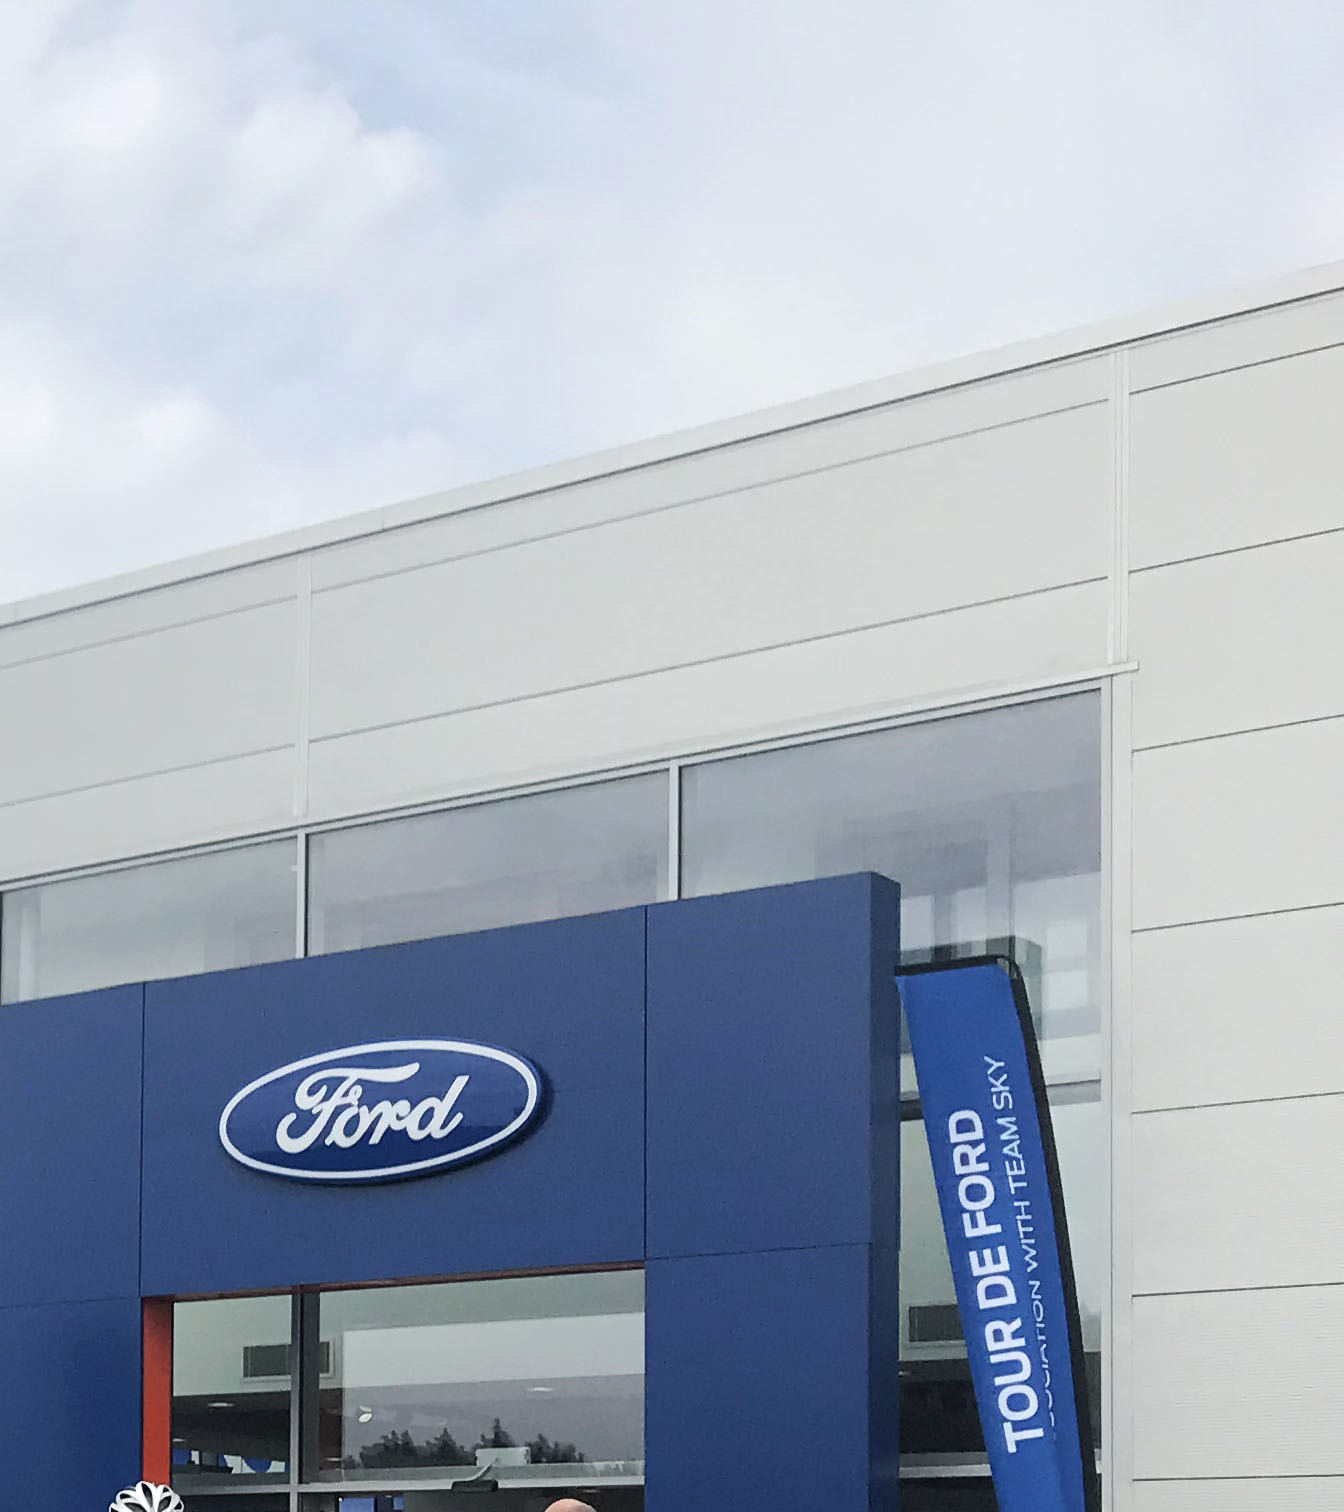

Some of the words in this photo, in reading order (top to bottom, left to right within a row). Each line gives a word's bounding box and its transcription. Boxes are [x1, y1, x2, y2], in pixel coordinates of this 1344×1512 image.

[276, 1062, 470, 1154] Ford
[984, 1055, 1013, 1110] SKY
[948, 1109, 1002, 1239] FORD
[996, 1116, 1028, 1195] TEAM
[1013, 1200, 1041, 1273] WITH
[969, 1245, 1017, 1310] DE
[985, 1318, 1045, 1454] TOUR
